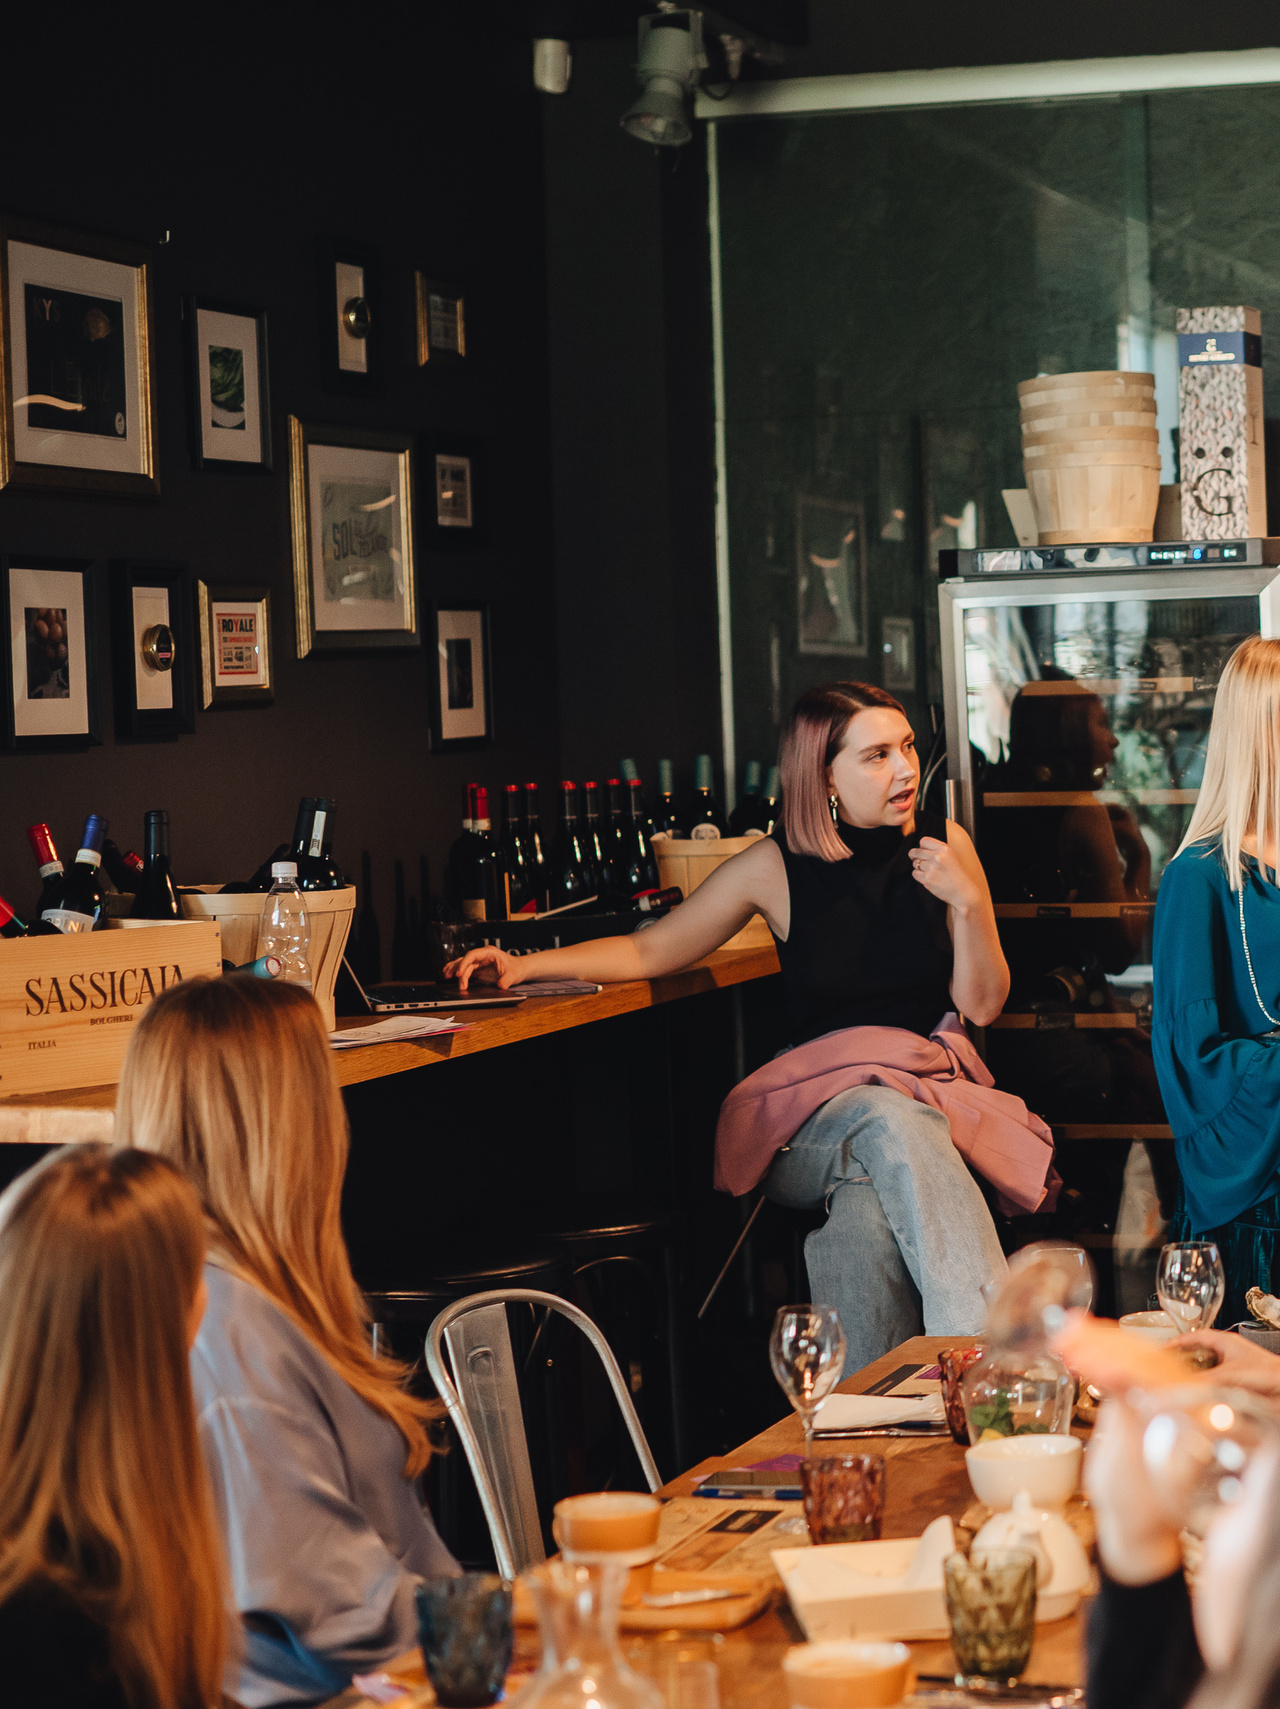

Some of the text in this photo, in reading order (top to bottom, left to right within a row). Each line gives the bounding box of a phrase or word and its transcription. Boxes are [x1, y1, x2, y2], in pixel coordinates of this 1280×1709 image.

[222, 618, 253, 632] ROYALE
[90, 1014, 133, 1026] BOLGHERI
[28, 1039, 57, 1050] ITALIA
